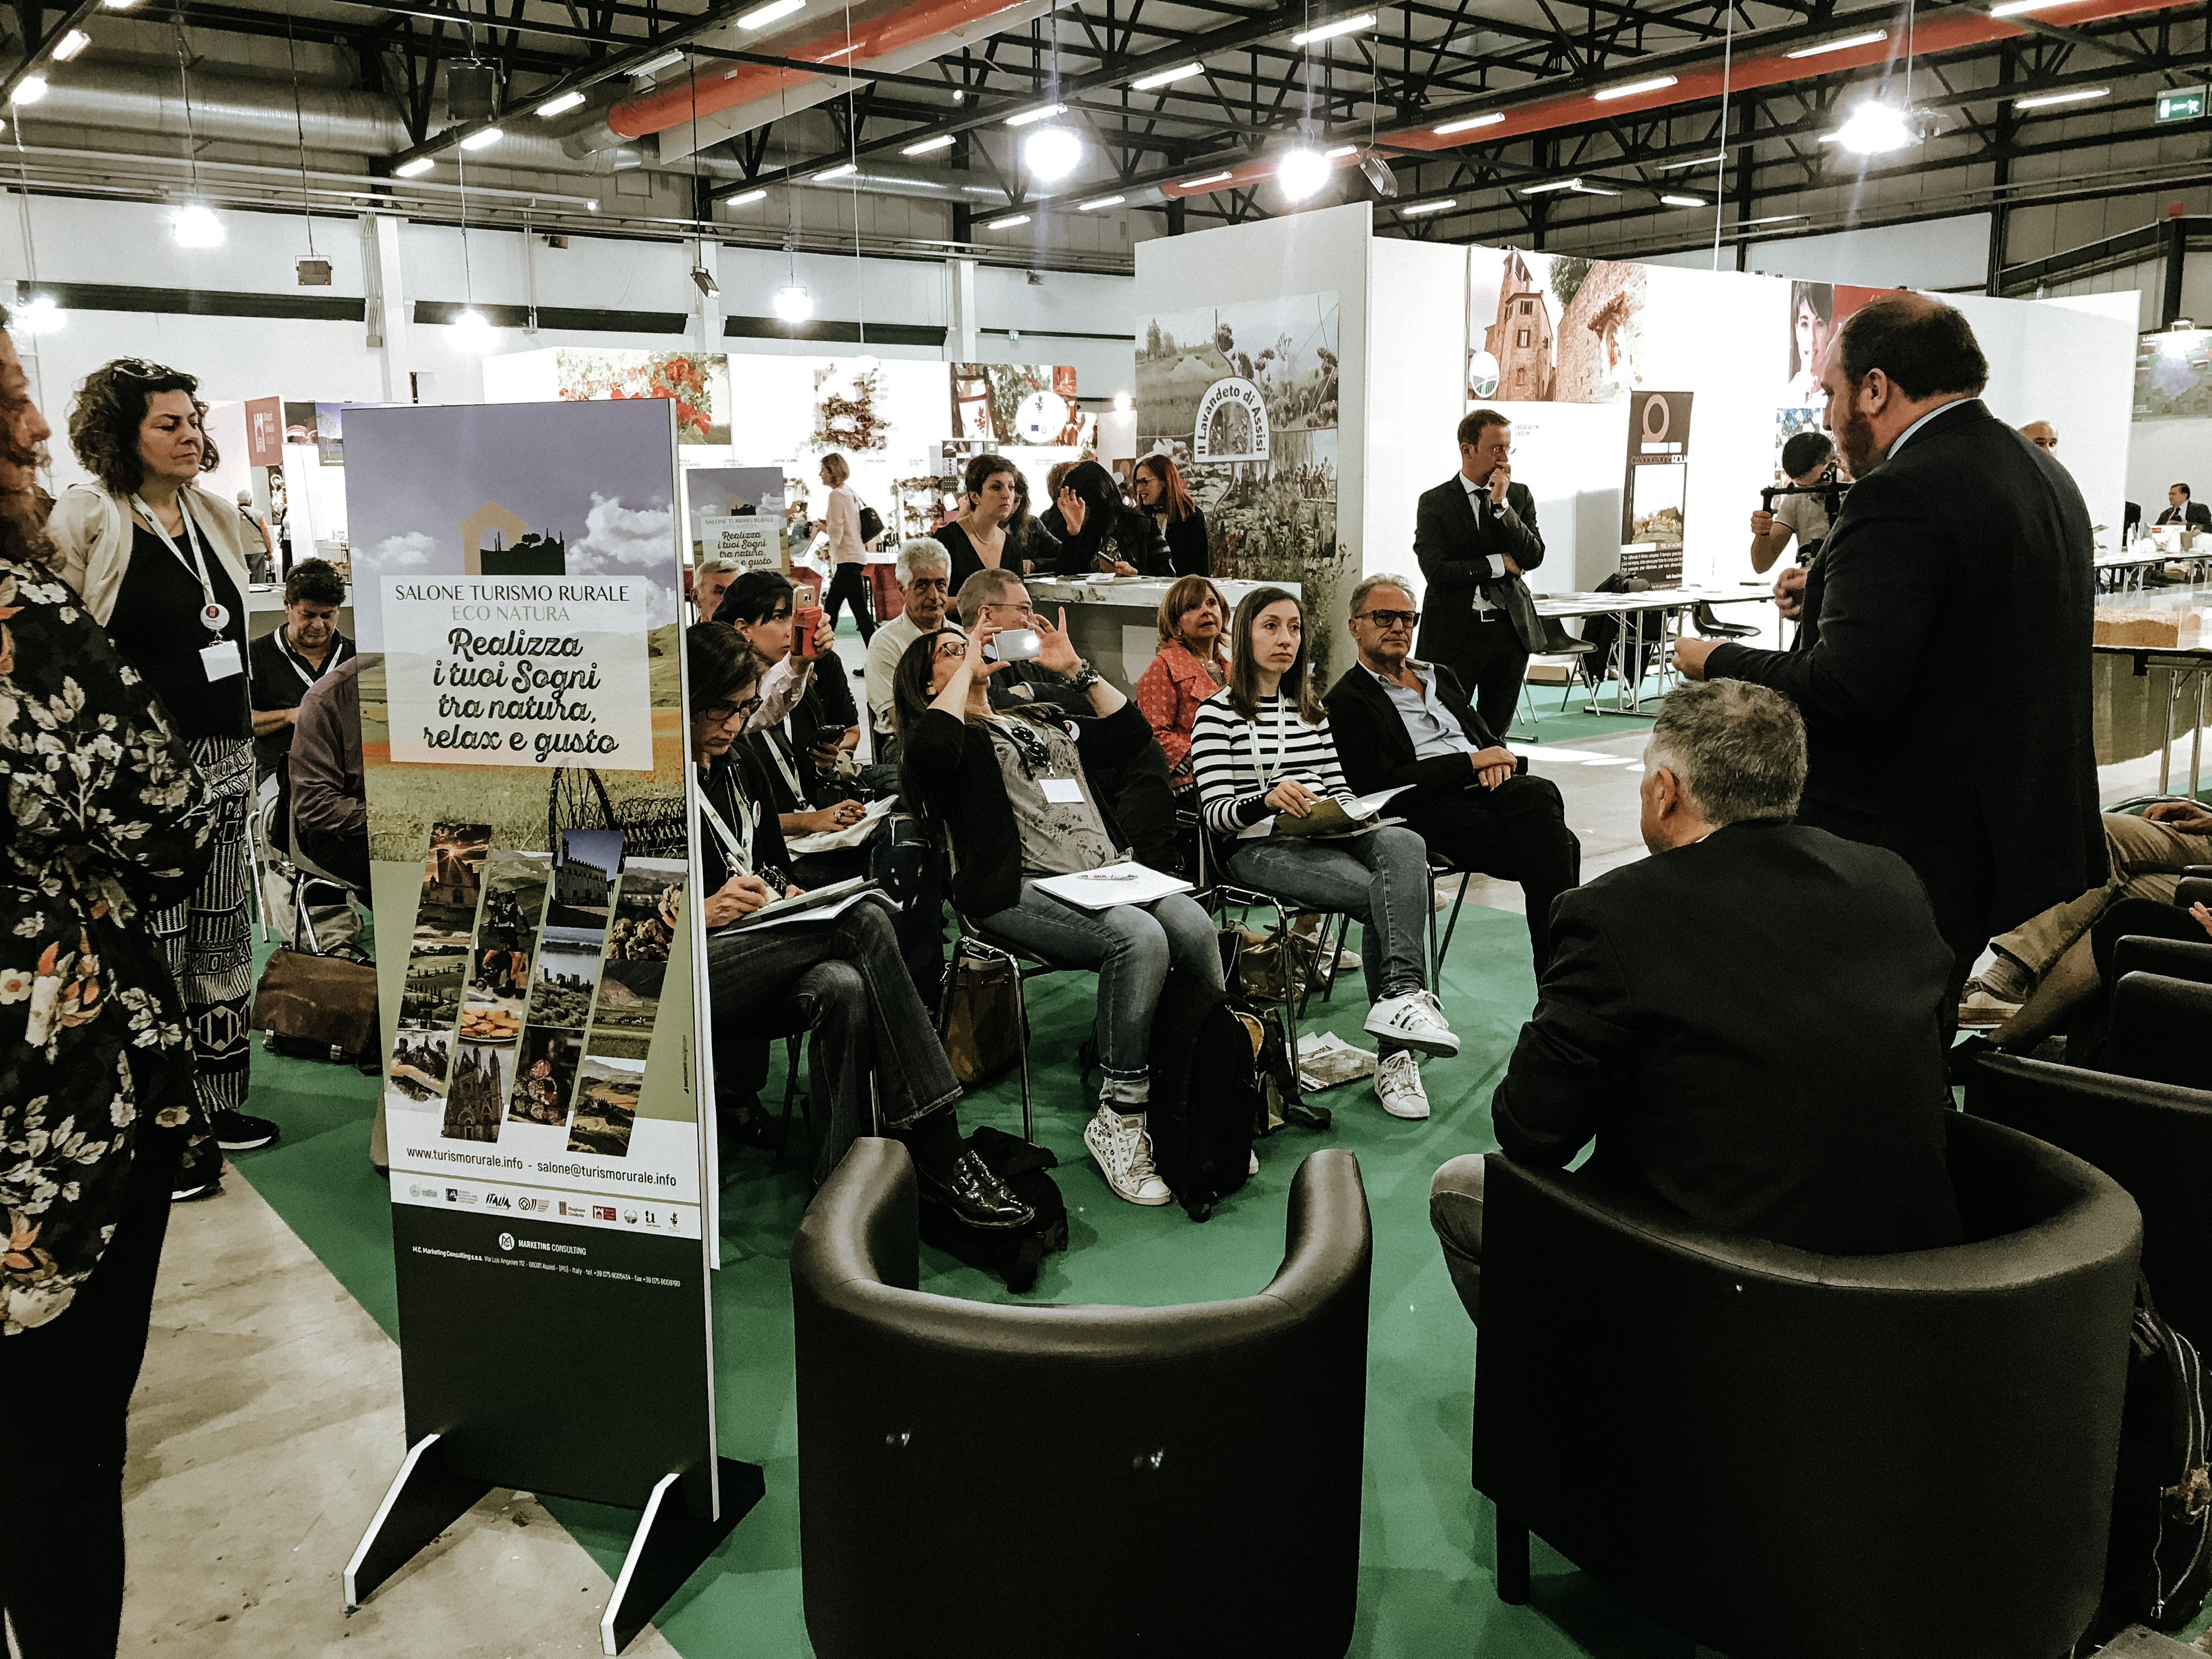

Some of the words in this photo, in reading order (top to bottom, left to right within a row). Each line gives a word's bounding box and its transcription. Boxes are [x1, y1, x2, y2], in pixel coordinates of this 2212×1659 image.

[1243, 390, 1255, 405] di
[1198, 385, 1240, 440] Lavandeto
[1251, 407, 1266, 452] Assisi
[1197, 445, 1206, 454] Il
[722, 531, 762, 541] Realizza
[718, 541, 721, 549] i
[723, 540, 740, 548] tuoi
[741, 539, 767, 552] Sogni
[748, 557, 772, 569] gusto
[395, 585, 464, 601] SALONE
[470, 585, 552, 601] TURISMO
[559, 585, 629, 602] RURALE
[452, 606, 490, 620] ECO
[496, 606, 570, 622] NATURA
[448, 628, 584, 662] Realizza
[433, 660, 445, 687] i
[449, 661, 508, 688] tuoi
[511, 659, 601, 699] Sogni
[438, 693, 485, 719] tra
[488, 695, 597, 723] natura,
[423, 724, 503, 750] relax
[509, 731, 528, 751] e
[534, 729, 619, 763] gusto
[407, 1148, 523, 1170] www.turismorurale.info
[537, 1161, 676, 1187] salone@turismorurale.info
[422, 1247, 446, 1257] Marketing
[447, 1250, 471, 1261] Consulting
[518, 1239, 550, 1251] MARKETING
[551, 1244, 586, 1255] CONSULTING
